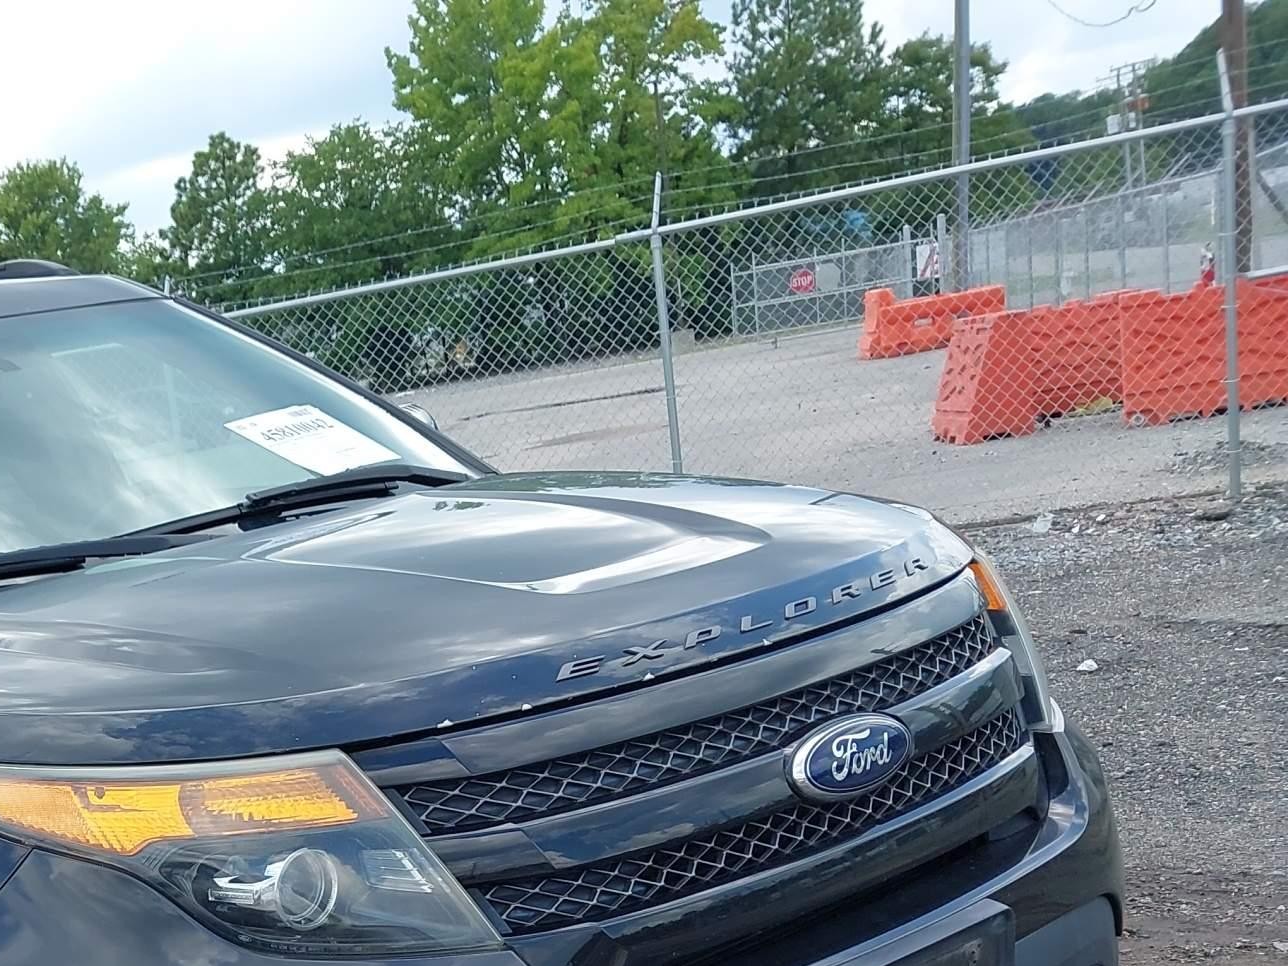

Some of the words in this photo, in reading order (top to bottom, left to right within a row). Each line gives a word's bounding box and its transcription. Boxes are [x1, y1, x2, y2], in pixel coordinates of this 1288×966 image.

[792, 274, 813, 287] STOP
[260, 418, 334, 442] 45810042
[555, 556, 930, 683] EXPLORER
[830, 727, 893, 783] Ford
